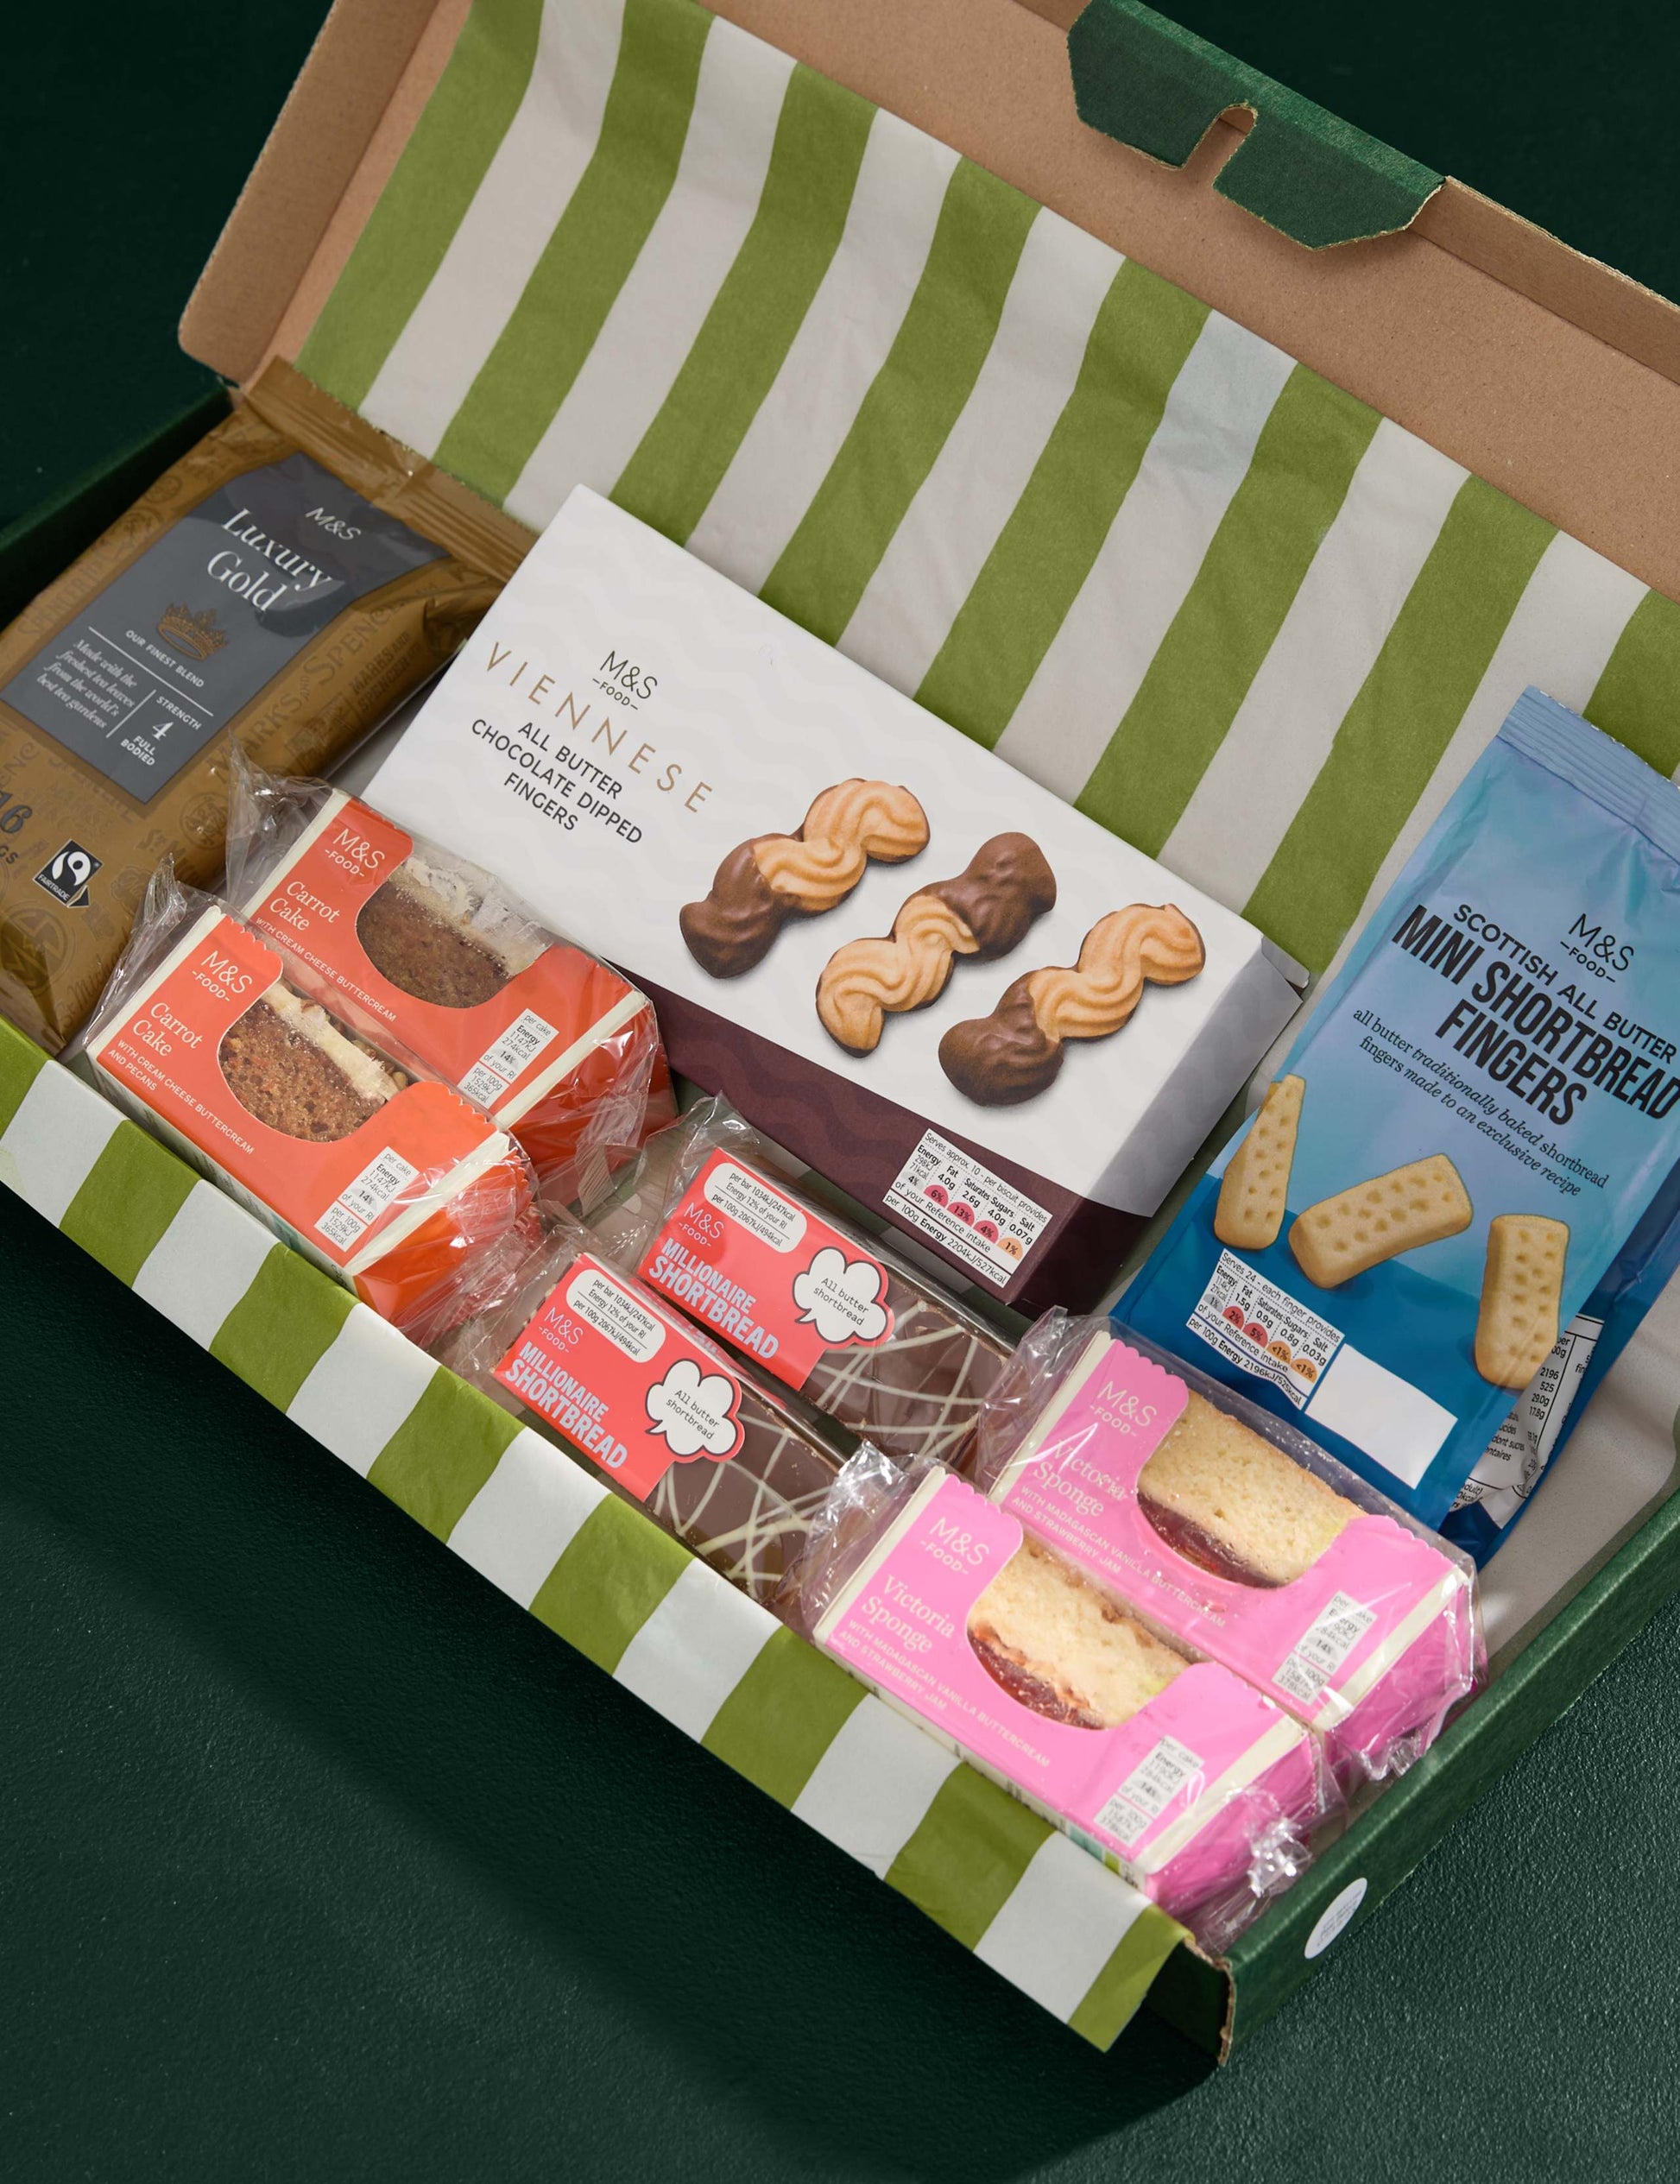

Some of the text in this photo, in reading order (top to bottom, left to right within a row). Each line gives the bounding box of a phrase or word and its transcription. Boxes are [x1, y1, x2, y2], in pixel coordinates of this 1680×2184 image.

[222, 508, 332, 590] Luxury
[306, 508, 362, 540] M&S
[207, 551, 287, 611] Gold
[126, 629, 204, 687] OUR FINEST BLEND
[599, 651, 658, 699] M&S
[152, 722, 174, 741] 4
[156, 697, 202, 729] STRENGTH
[487, 642, 713, 813] VIENNESE
[121, 739, 155, 766] BODIED
[133, 735, 156, 755] FULL
[518, 722, 622, 799] ALL BUTTER
[471, 719, 642, 843] CHOCOLATE DIPPED
[504, 772, 578, 830] FINGERS
[332, 829, 385, 868] M&S
[37, 874, 70, 901] FAIRTRADE
[269, 898, 310, 931] Cake
[287, 881, 340, 923] Carrot
[256, 918, 276, 934] WITH
[275, 931, 305, 956] CREAM
[304, 951, 338, 980] CHEESE
[337, 975, 396, 1022] BUTTERCREAM
[1568, 912, 1635, 971] M&S
[201, 950, 253, 994] M&S
[1454, 904, 1677, 1064] SCOTTISH ALL BUTTER
[133, 1019, 173, 1057] Cake
[150, 1002, 203, 1049] Carrot
[1391, 904, 1680, 1120] MINI SHORTBREAD
[108, 1050, 156, 1090] AND PECANS
[1435, 999, 1587, 1125] FINGERS
[117, 1039, 255, 1155] WITH CREAM CHEESE BUTTERCREAM
[1354, 1010, 1609, 1189] all butter traditionally baked shortbread
[1359, 1036, 1582, 1196] fingers made to an exclusive recipe
[376, 1164, 400, 1185] Energy
[729, 1172, 743, 1184] per
[741, 1179, 753, 1190] bar
[917, 1145, 1035, 1232] Energy Fat Saturates Sugars Salt
[925, 1133, 1047, 1223] Serves approx. 10 per biscuit provides
[348, 1198, 366, 1214] your
[683, 1202, 725, 1239] M&S
[711, 1193, 726, 1206] per
[723, 1202, 739, 1215] 100g
[726, 1182, 786, 1229] Energy 12% of your RI
[894, 1181, 991, 1253] of your Reference intake
[885, 1193, 1007, 1284] per 100g Energy 2204kJ/527kcal
[661, 1238, 756, 1314] MILLIONAIRE
[821, 1278, 869, 1314] All butter
[1222, 1253, 1340, 1342] Serves 24 each finger provides
[544, 1307, 584, 1345] M&S
[649, 1256, 779, 1359] SHORTBREAD
[813, 1286, 865, 1326] shortbread
[1216, 1266, 1329, 1352] Energy Fat Saturates Sugars Salt
[1189, 1317, 1302, 1405] per 100g Energy 2196kJ/525kcal
[1197, 1303, 1289, 1373] of your Reference intake
[519, 1341, 609, 1423] MILLIONAIRE
[1539, 1381, 1554, 1392] 525
[1540, 1367, 1559, 1379] 2196
[506, 1359, 628, 1468] SHORTBREAD
[666, 1398, 715, 1440] shortbread
[674, 1390, 720, 1428] All butter
[1096, 1380, 1158, 1427] M&S
[1033, 1461, 1105, 1517] Sponge
[929, 1517, 990, 1566] M&S
[862, 1595, 933, 1653] Sponge
[882, 1575, 956, 1639] Victoria
[839, 1630, 947, 1711] AND STRAWBERRY JAM
[849, 1619, 1050, 1768] WITH MADAGASCAN VANILLA BUTTERCREAM
